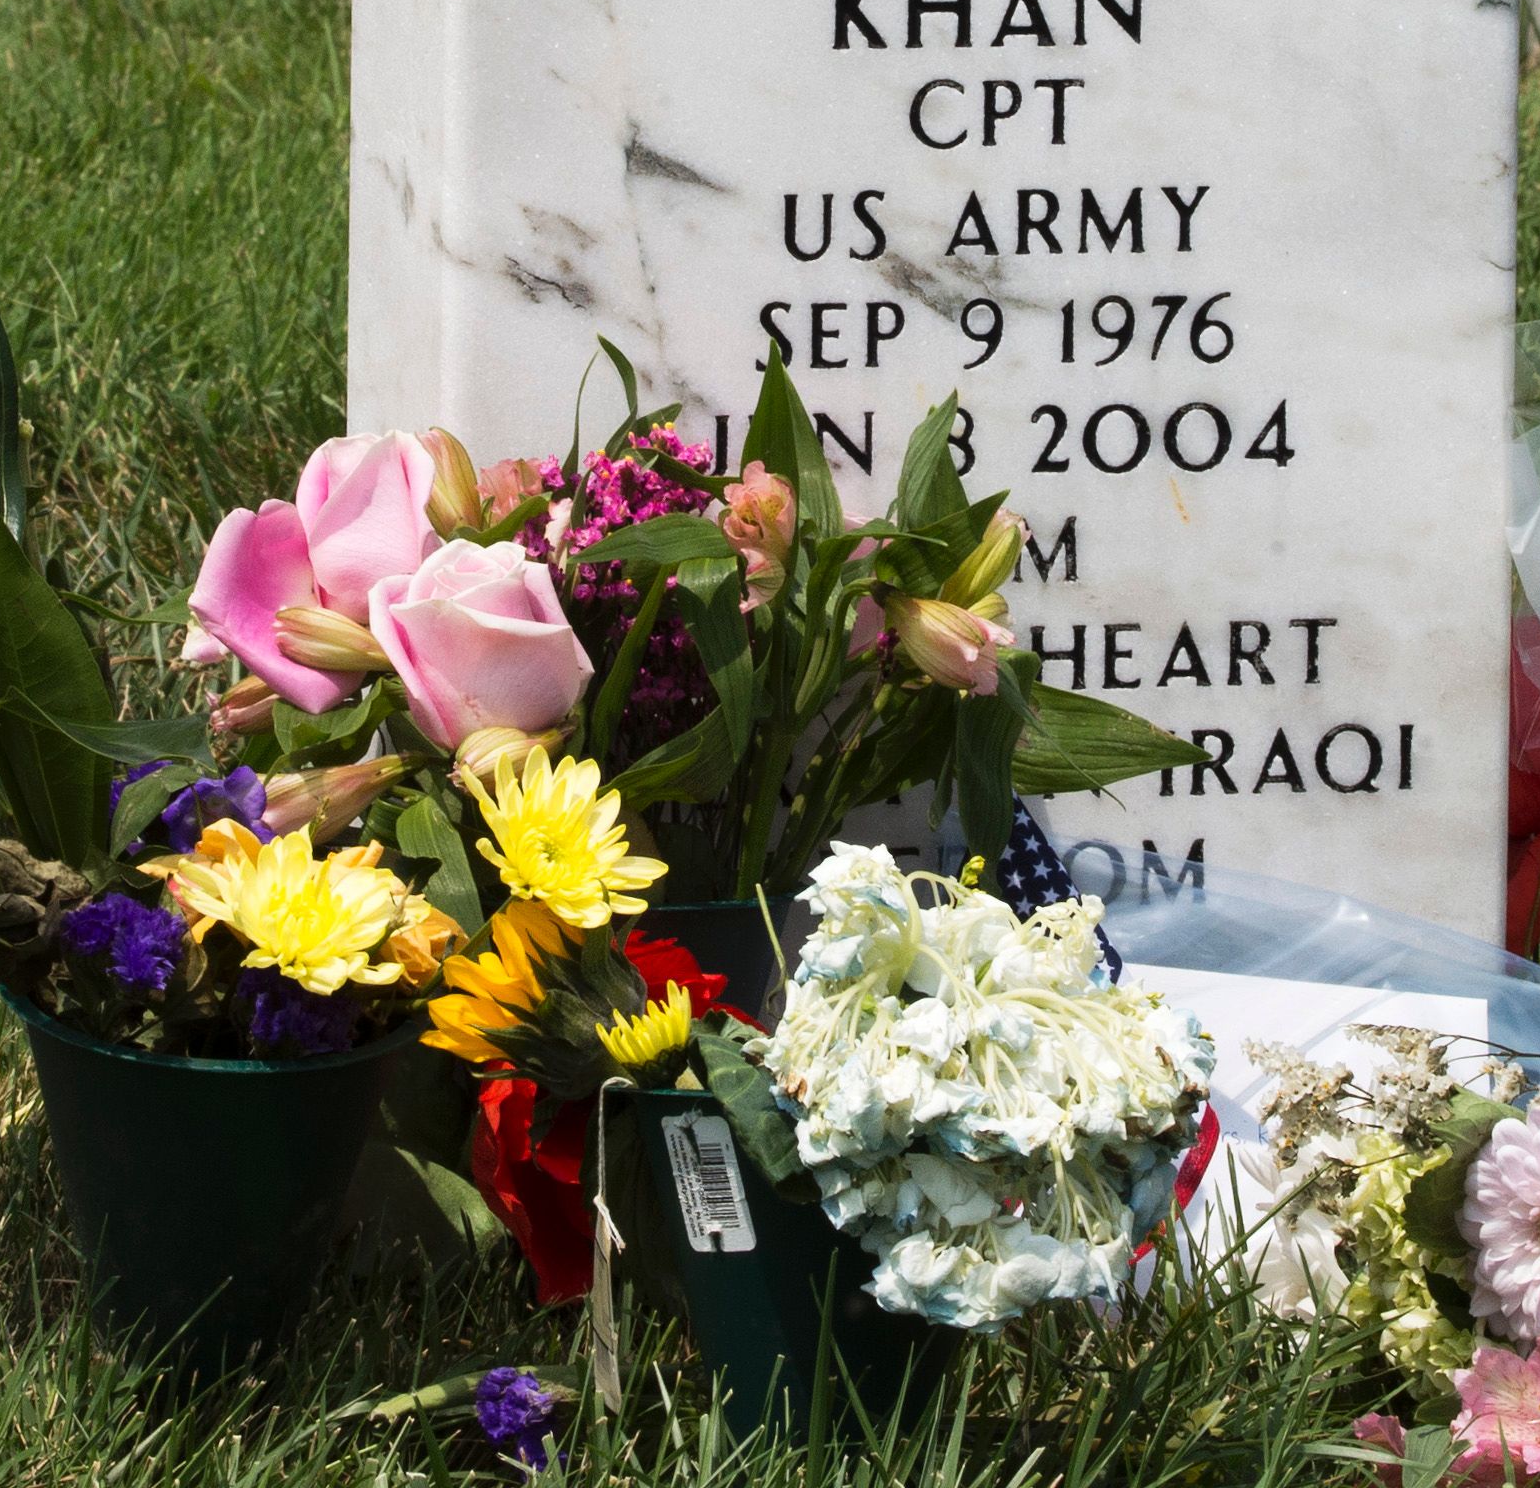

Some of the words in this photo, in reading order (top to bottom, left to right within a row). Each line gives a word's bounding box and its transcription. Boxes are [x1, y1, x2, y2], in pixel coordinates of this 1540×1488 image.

[908, 78, 1086, 151] CPT
[783, 188, 887, 263] US
[945, 184, 1211, 258] ARMY
[754, 300, 906, 373] SEP
[960, 297, 1004, 370] 9
[1061, 291, 1235, 368] 1976
[711, 410, 874, 478] JN
[1030, 399, 1295, 475] 2004
[1029, 616, 1338, 690] HEART
[1157, 722, 1414, 798] IRAQI
